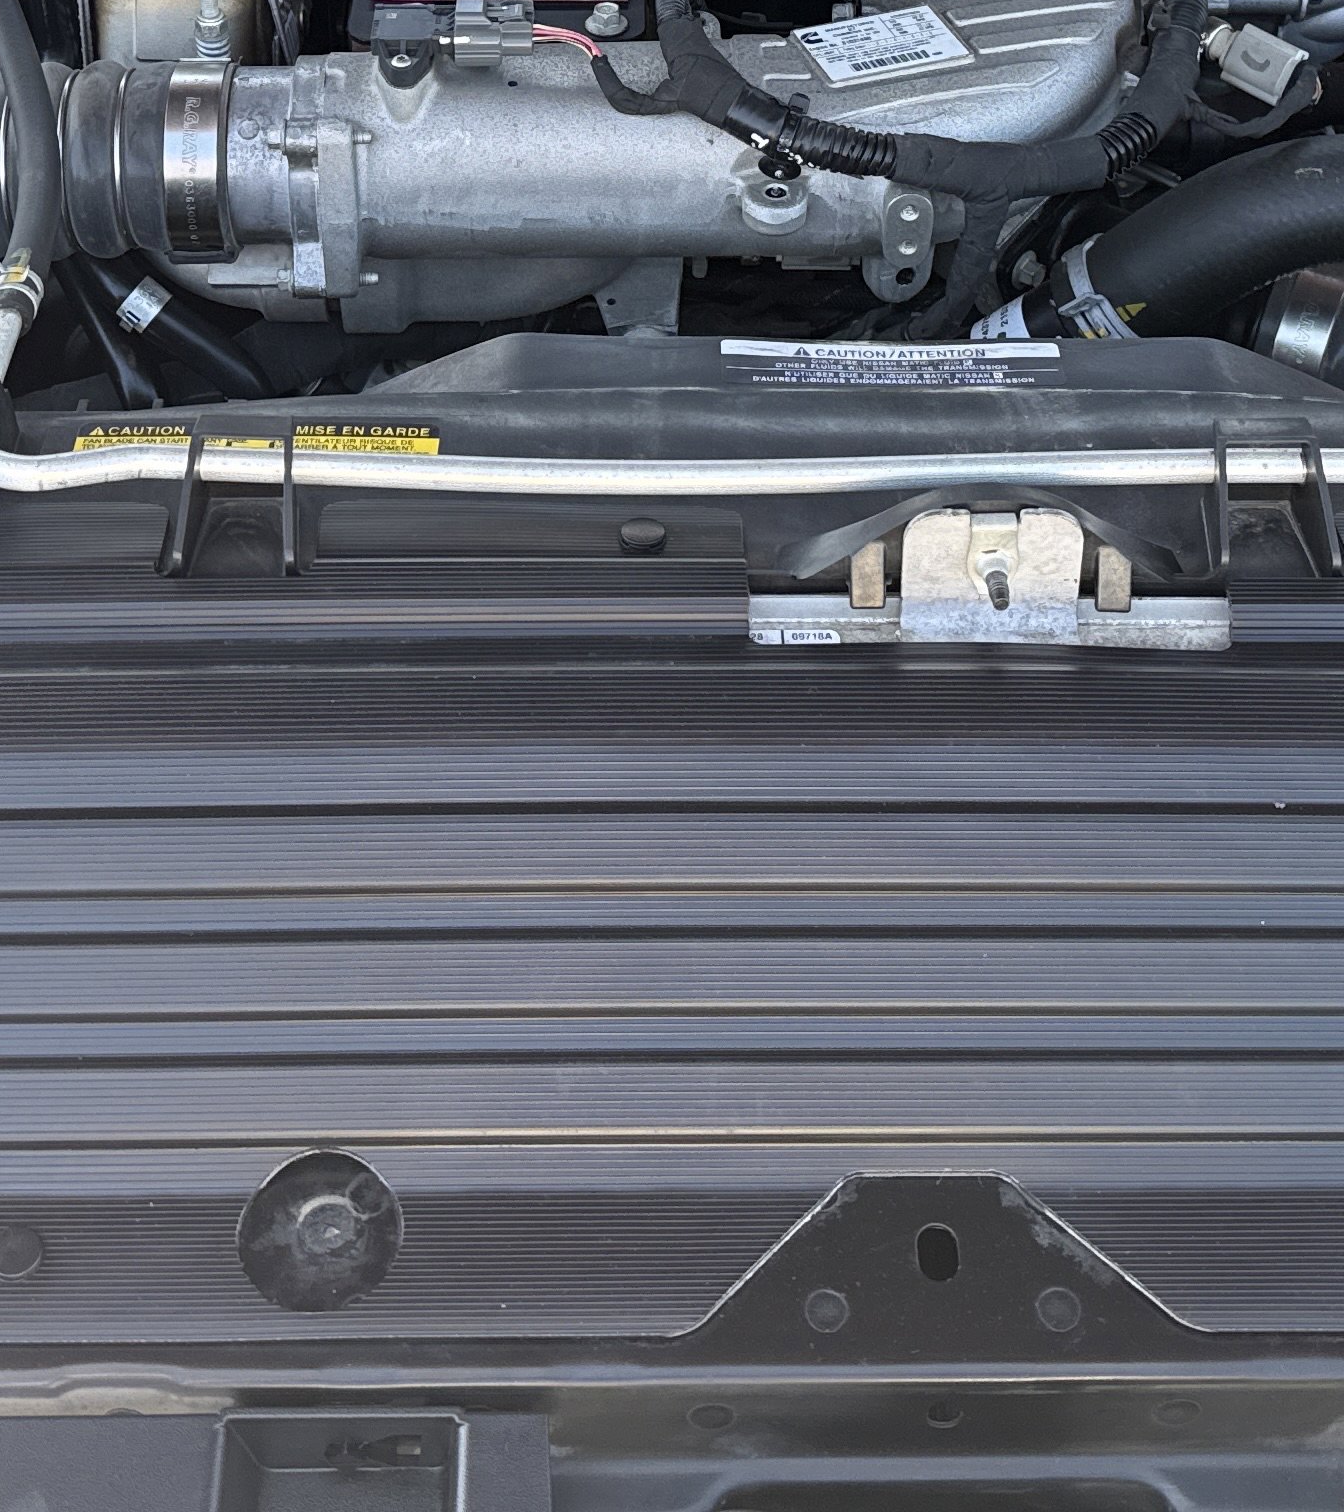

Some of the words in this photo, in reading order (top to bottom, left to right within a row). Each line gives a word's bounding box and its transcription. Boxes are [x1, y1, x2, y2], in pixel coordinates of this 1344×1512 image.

[815, 348, 986, 359] CAUTION/ATTENTION
[108, 426, 185, 436] CAUTION
[296, 425, 336, 435] MISE
[342, 426, 365, 436] EN
[370, 427, 430, 437] GARDE
